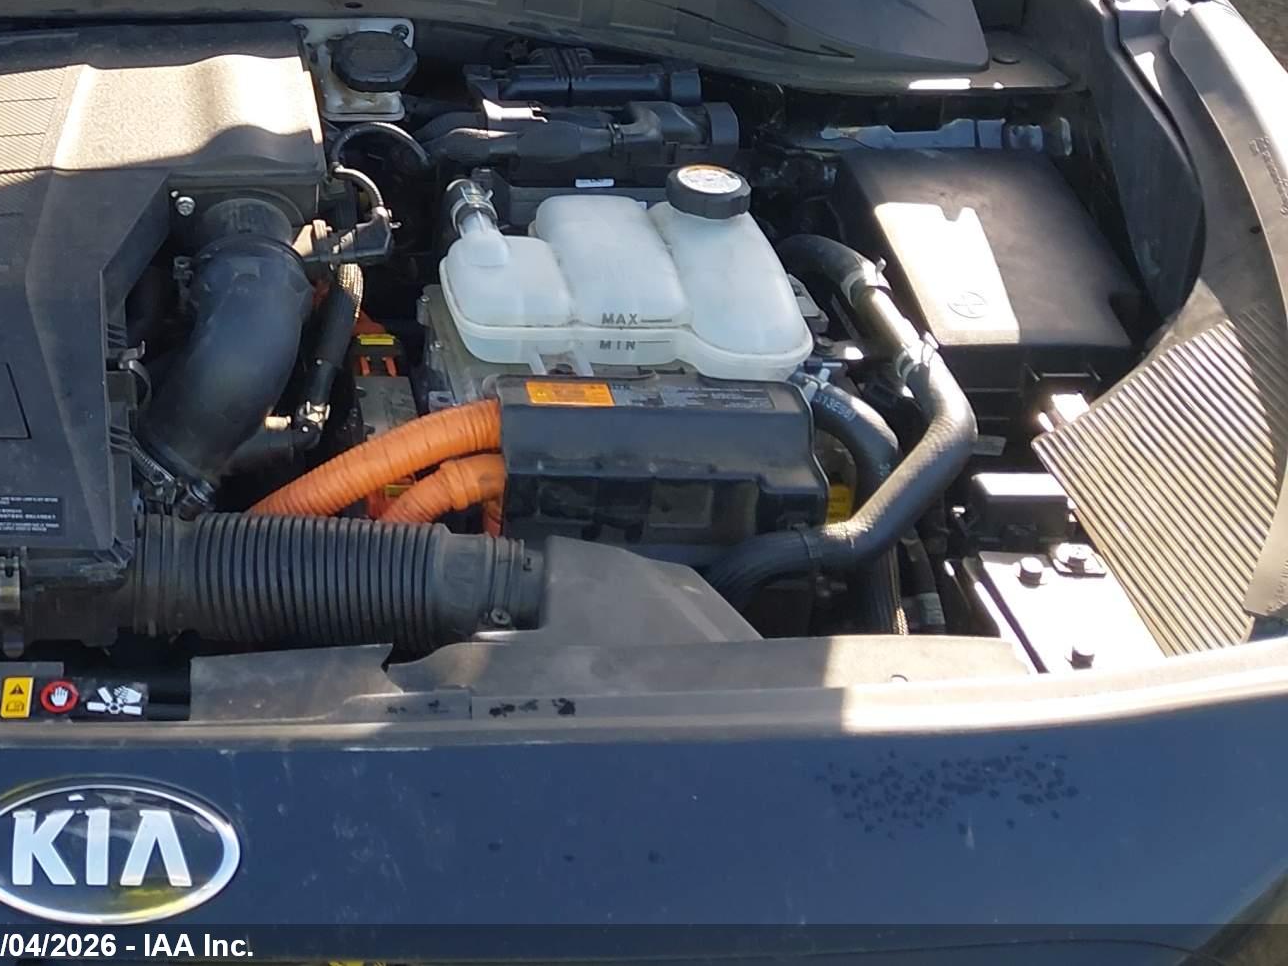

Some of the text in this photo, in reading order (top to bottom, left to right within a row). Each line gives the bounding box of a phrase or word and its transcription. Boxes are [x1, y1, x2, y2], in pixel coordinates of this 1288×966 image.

[601, 313, 638, 325] MAX
[599, 339, 636, 351] MIN
[12, 809, 193, 887] KIA
